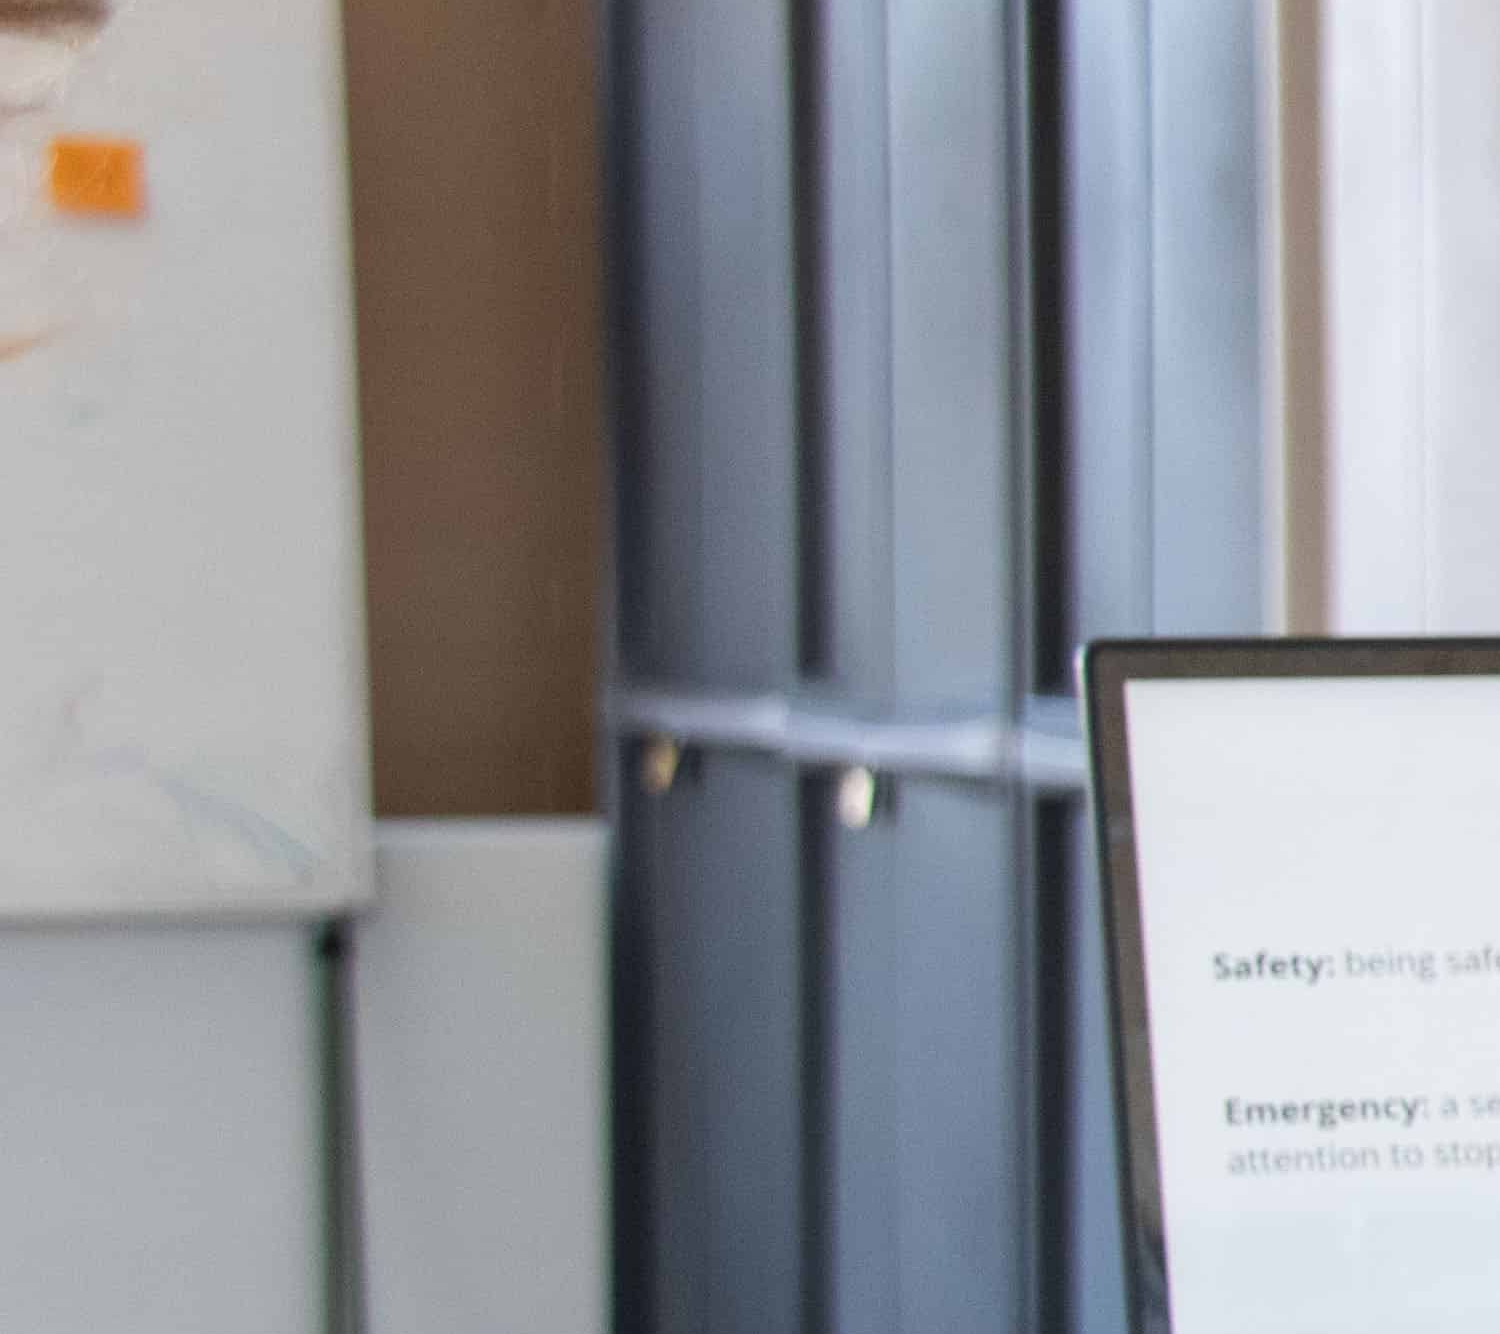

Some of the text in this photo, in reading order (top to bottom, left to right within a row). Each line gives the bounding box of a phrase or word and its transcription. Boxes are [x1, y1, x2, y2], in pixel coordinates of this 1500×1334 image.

[1212, 948, 1335, 985] Safety:
[1345, 947, 1437, 982] being
[1223, 1096, 1430, 1130] Emergency:
[1439, 1094, 1460, 1118] a
[1228, 1142, 1380, 1175] attention
[1389, 1142, 1424, 1167] to
